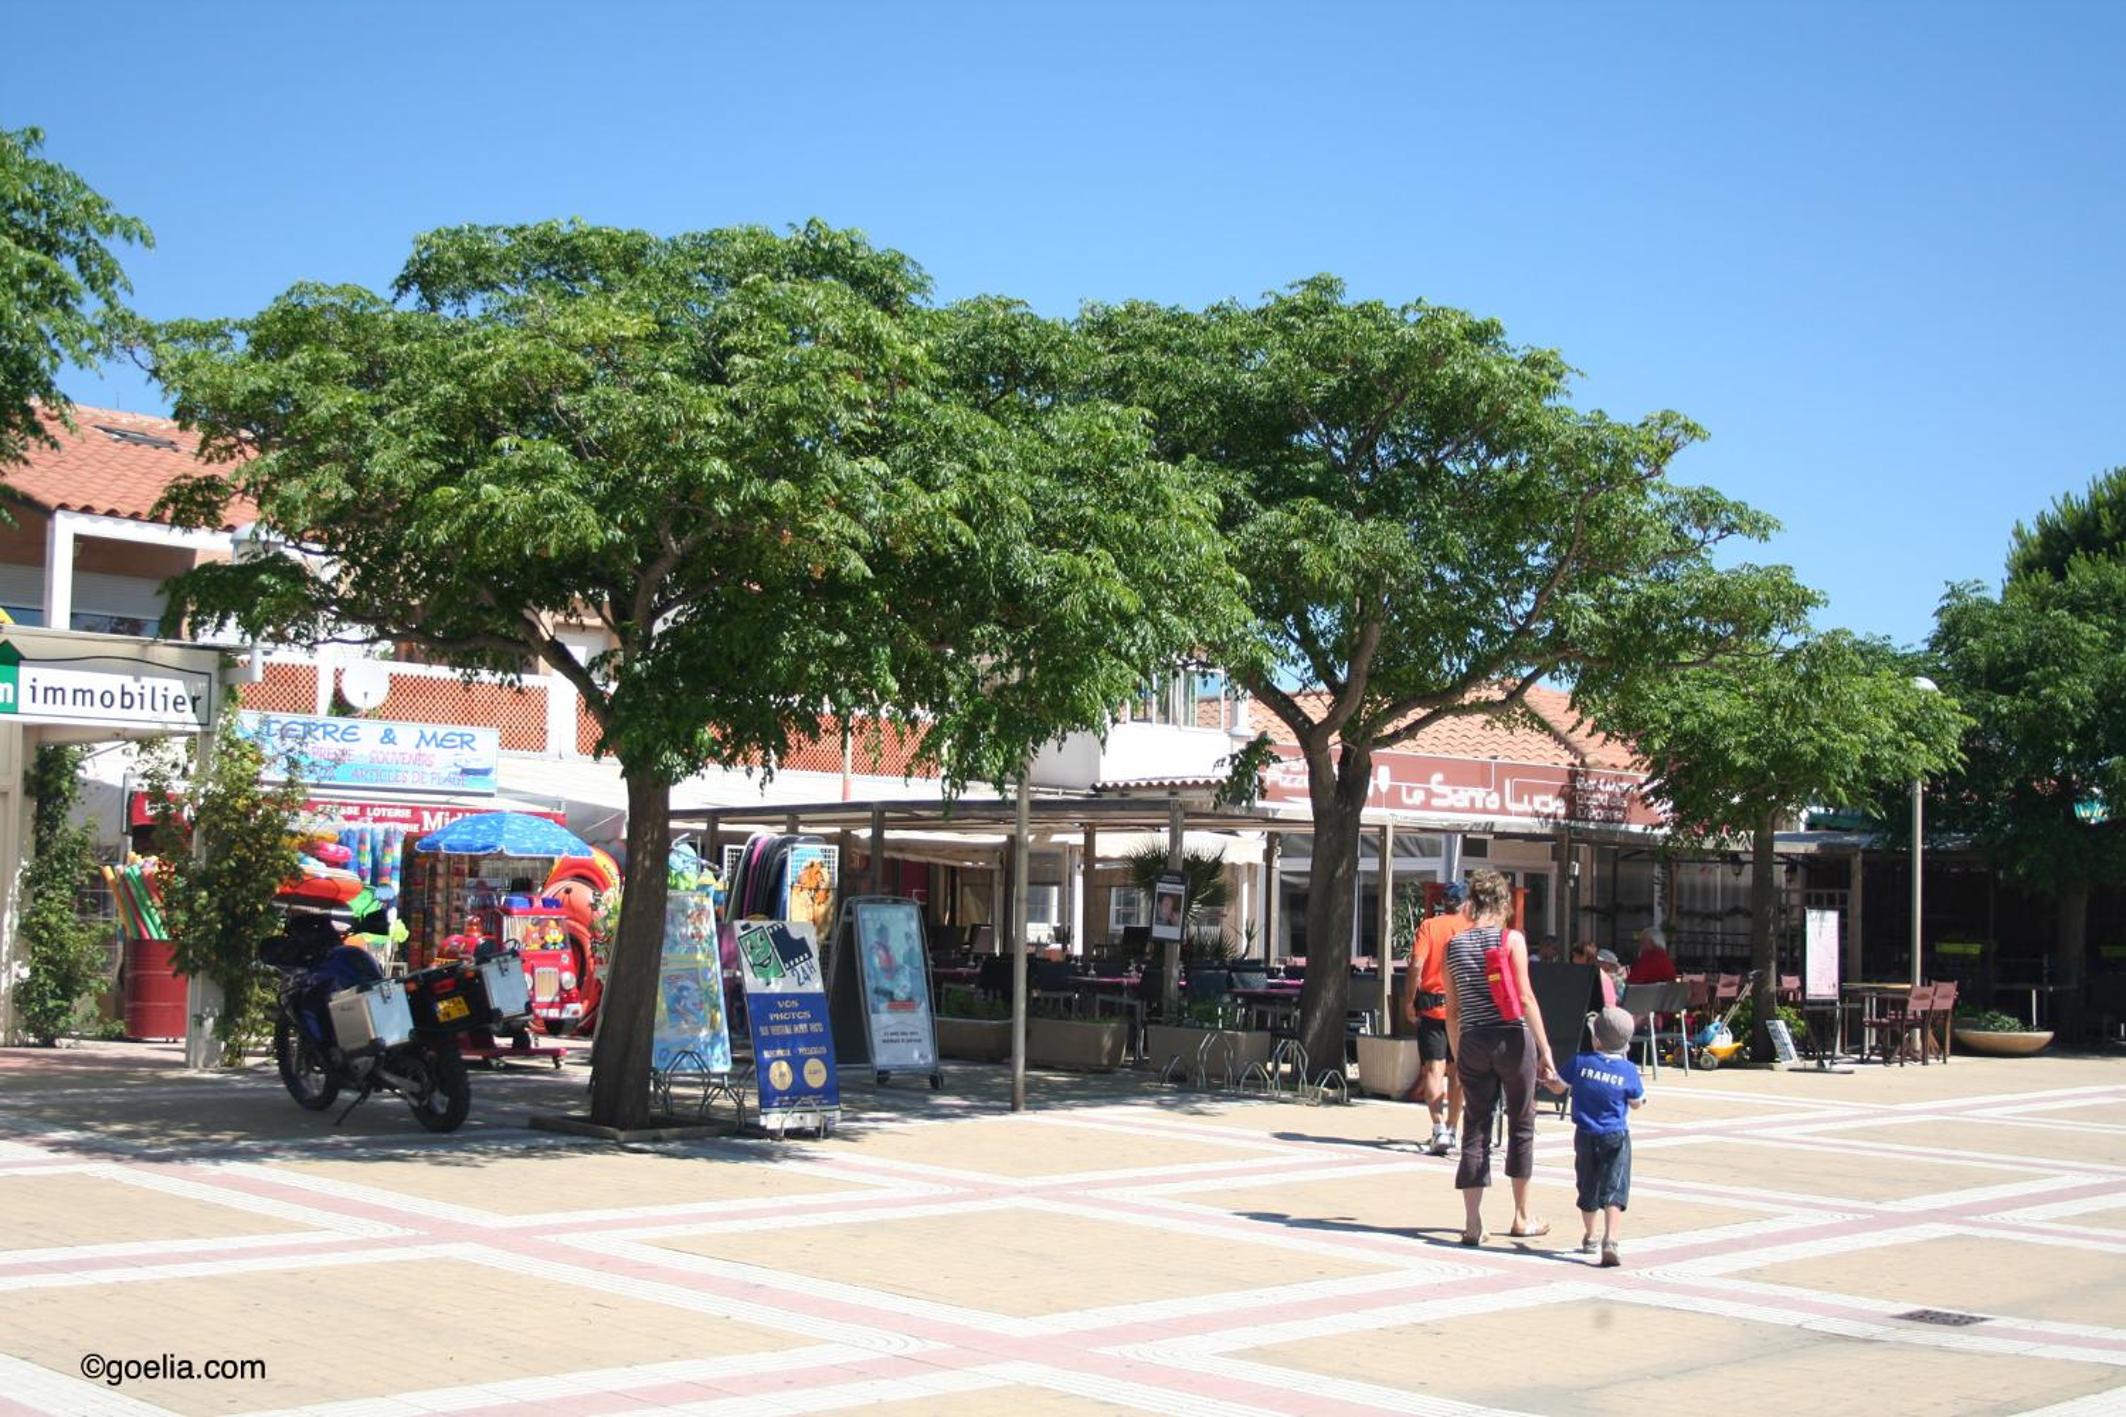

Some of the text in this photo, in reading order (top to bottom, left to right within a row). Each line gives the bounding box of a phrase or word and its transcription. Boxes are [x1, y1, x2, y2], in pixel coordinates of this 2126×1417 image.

[29, 677, 202, 714] immobilier
[263, 718, 477, 751] TERRE & MER
[366, 806, 412, 818] LOTERIE
[769, 1010, 811, 1021] PHOTOS
[1580, 1067, 1624, 1086] FRANCE
